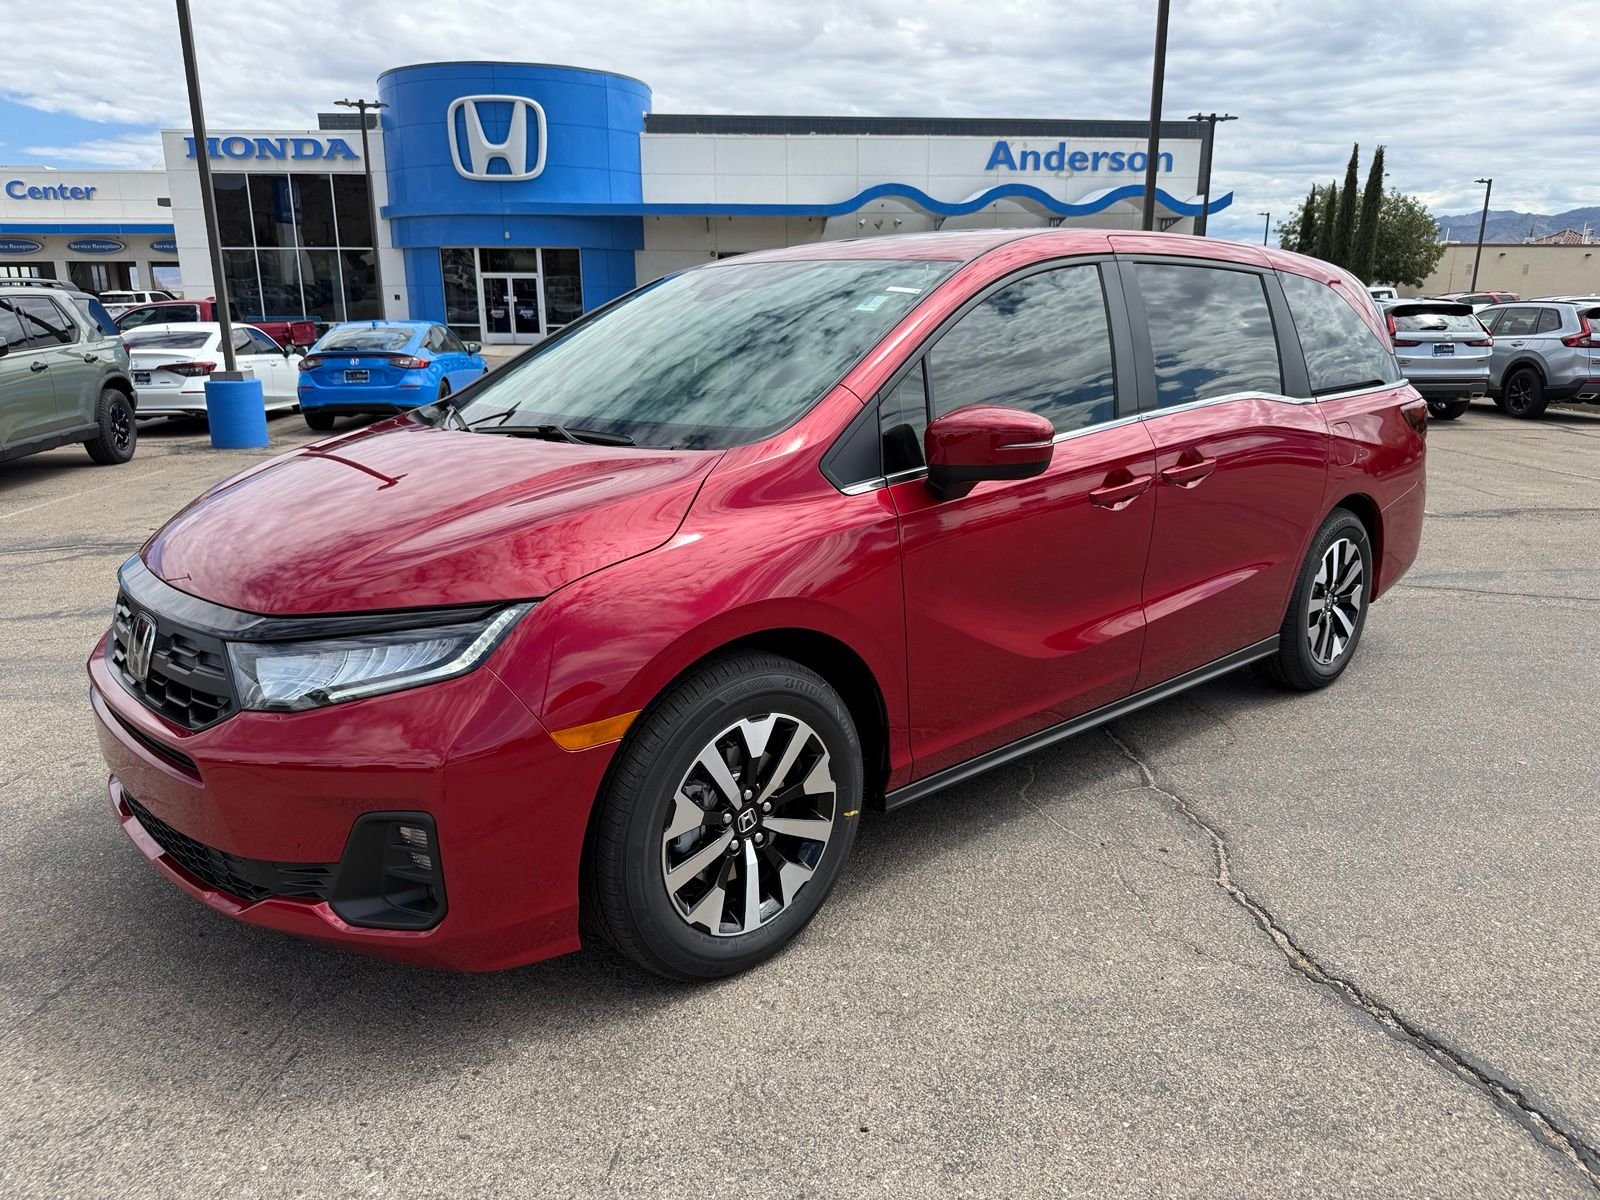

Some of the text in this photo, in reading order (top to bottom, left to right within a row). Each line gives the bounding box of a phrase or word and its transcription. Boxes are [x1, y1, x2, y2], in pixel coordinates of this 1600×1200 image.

[184, 136, 360, 160] HONDA
[984, 140, 1174, 173] Anderson
[5, 180, 97, 201] Center
